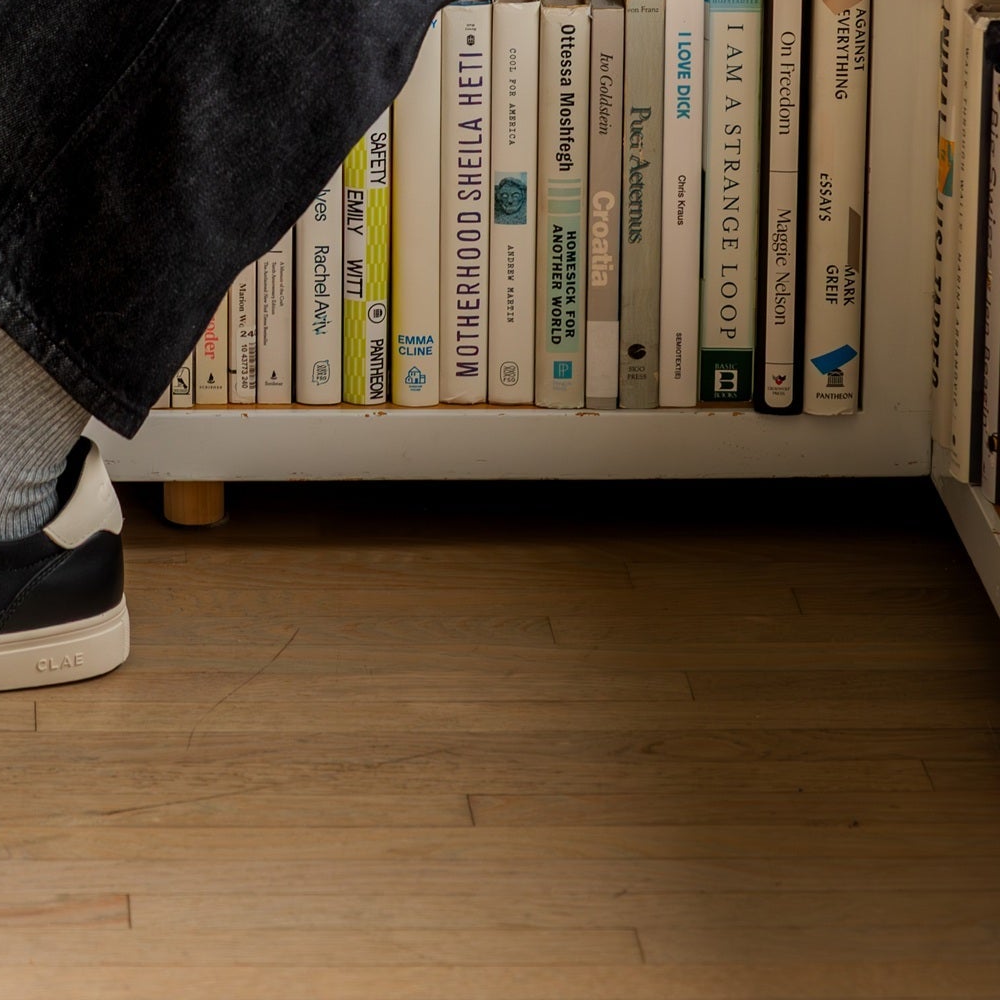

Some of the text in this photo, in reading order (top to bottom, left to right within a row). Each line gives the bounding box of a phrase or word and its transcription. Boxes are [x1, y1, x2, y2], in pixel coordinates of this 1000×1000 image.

[678, 42, 692, 79] LOVE
[726, 44, 743, 82] AM
[834, 8, 851, 101] EVERYTHING
[855, 8, 867, 70] AGAINST
[509, 48, 517, 145] COOL FOR AMERICA
[556, 24, 576, 171] Ottessa Moshfegh
[599, 52, 614, 134] Ivo Goldstein
[677, 84, 691, 119] DICK
[725, 95, 742, 112] A
[779, 31, 796, 134] On Freedom
[369, 131, 387, 185] SAFETY
[722, 124, 742, 250] STRANGE
[456, 52, 483, 376] MOTHERHOOD SHEILA HETI
[677, 174, 687, 226] Chris Kraus
[817, 172, 833, 223] ESSAYS
[345, 189, 364, 299] EMILY WITT
[590, 190, 615, 288] Croatia
[772, 210, 792, 325] Maggie Nelson
[312, 245, 331, 335] Rachel Aviv
[507, 244, 515, 322] ANDREW MARTIN
[551, 224, 563, 344] ANOTHER WORLD
[565, 230, 577, 337] HOMESICK FOR
[720, 264, 738, 339] LOOP
[826, 264, 839, 304] GREIF
[842, 263, 856, 307] MARK
[369, 338, 384, 400] PANTHEON
[398, 334, 434, 345] EMMA
[398, 346, 433, 356] CLINE
[674, 332, 683, 380] SEMIOTEXT(E)
[816, 392, 854, 400] PANTHEON
[36, 652, 85, 672] CLAE
